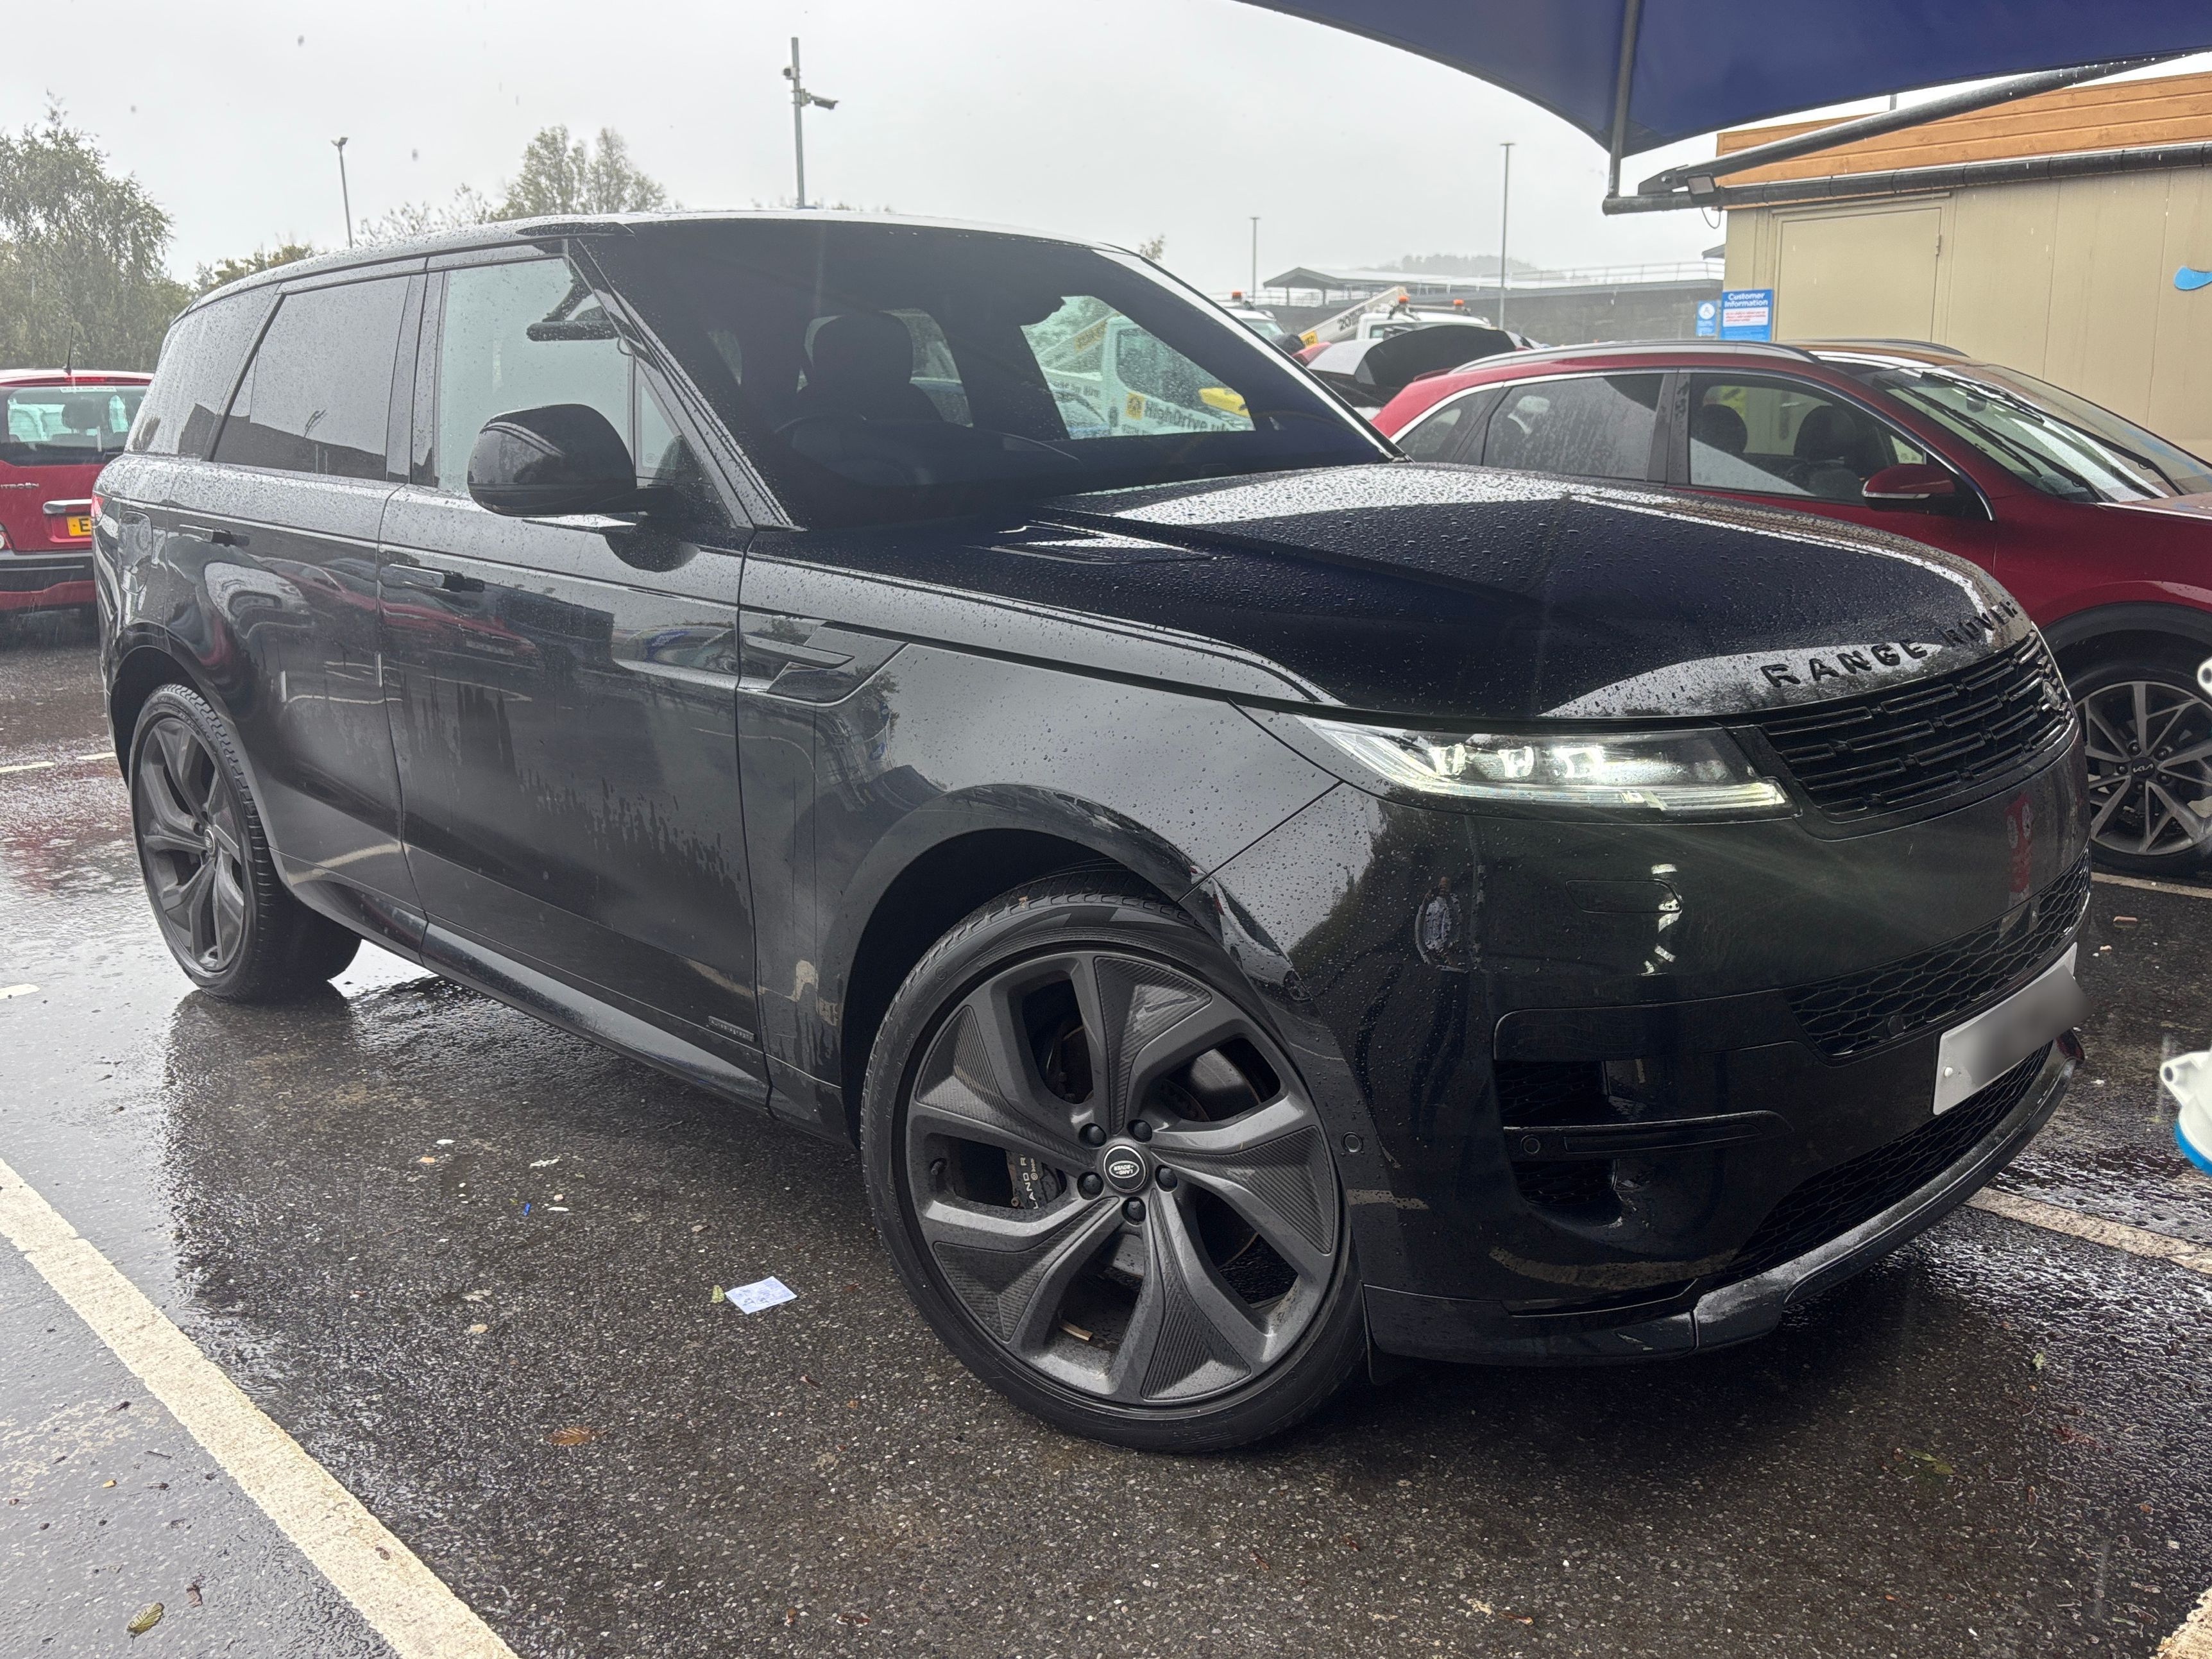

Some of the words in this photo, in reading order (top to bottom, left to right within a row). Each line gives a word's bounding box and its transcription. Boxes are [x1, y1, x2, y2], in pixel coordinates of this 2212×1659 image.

[1724, 300, 1769, 308] Information
[1728, 293, 1765, 301] Customer
[1760, 640, 1928, 687] RANGE
[1023, 1172, 1039, 1210] LAND
